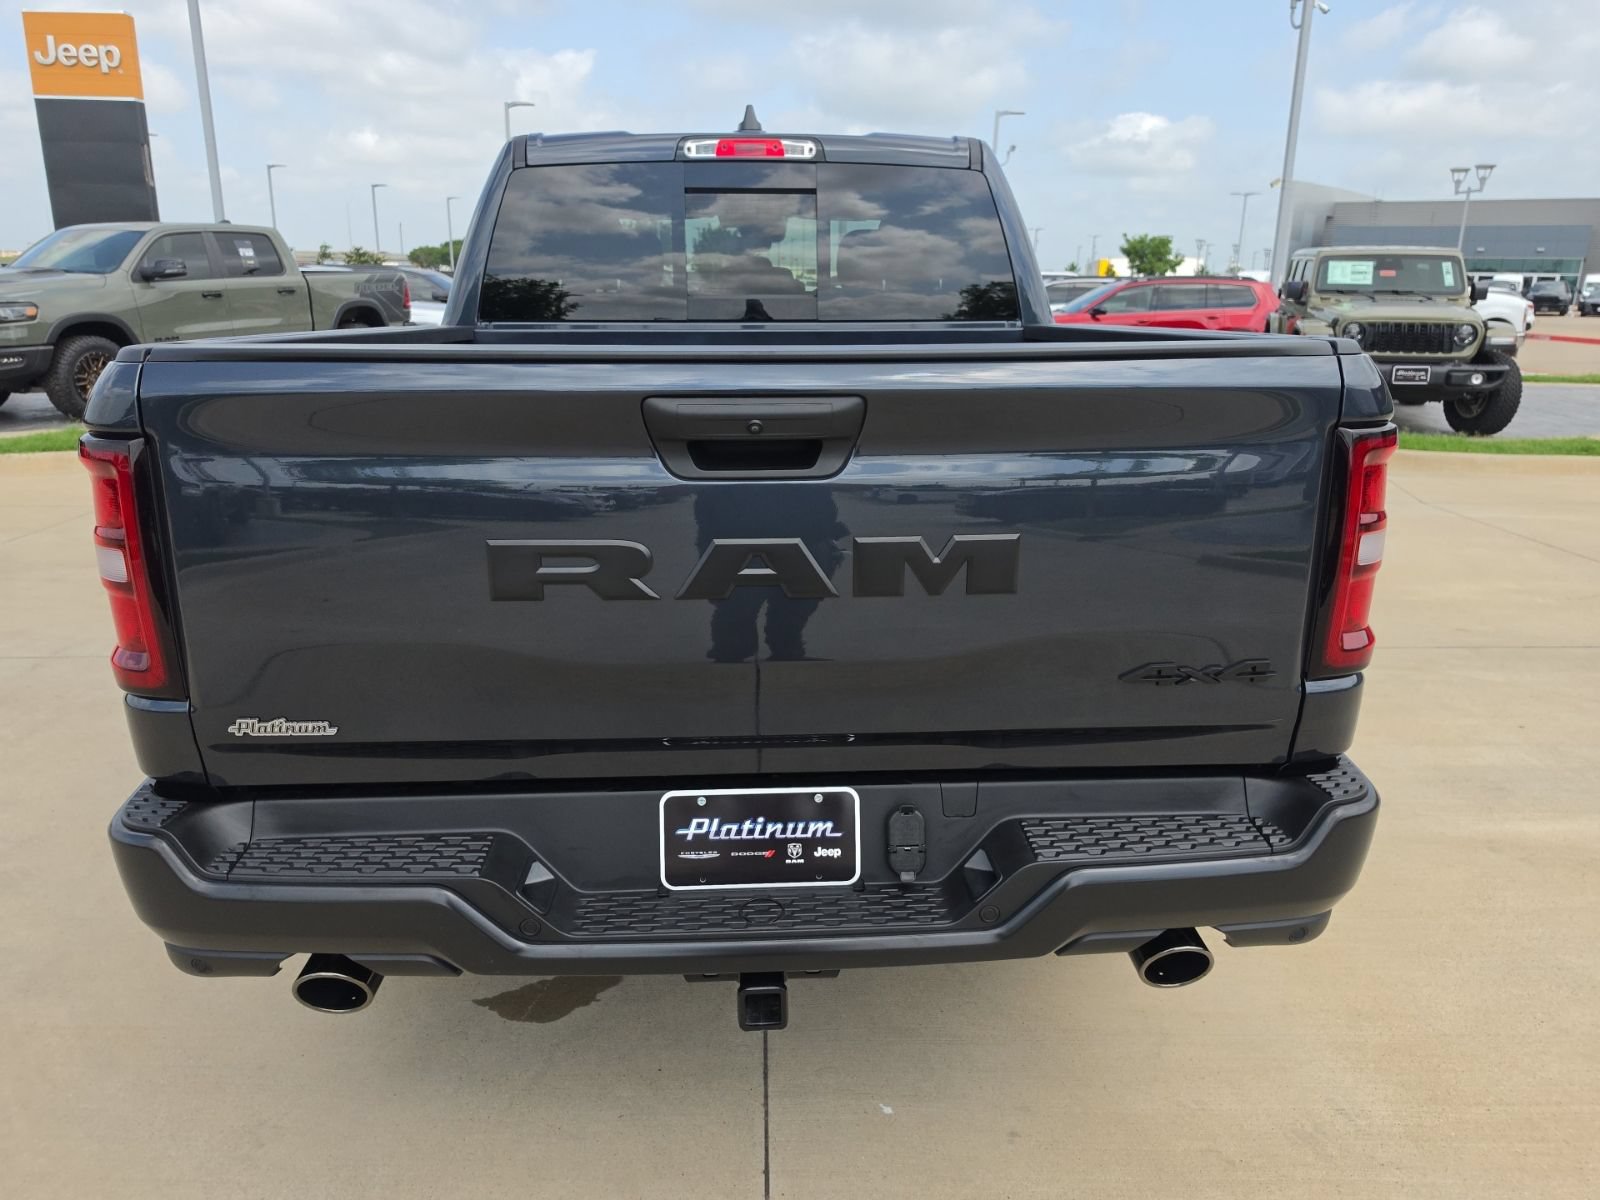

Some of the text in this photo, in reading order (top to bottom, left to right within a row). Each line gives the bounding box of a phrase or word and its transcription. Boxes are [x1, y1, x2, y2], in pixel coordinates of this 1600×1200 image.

[34, 34, 121, 74] Jeep
[486, 533, 1020, 601] RAM
[228, 717, 338, 737] Platinum
[675, 816, 844, 840] Platinum
[813, 846, 842, 859] Jeep
